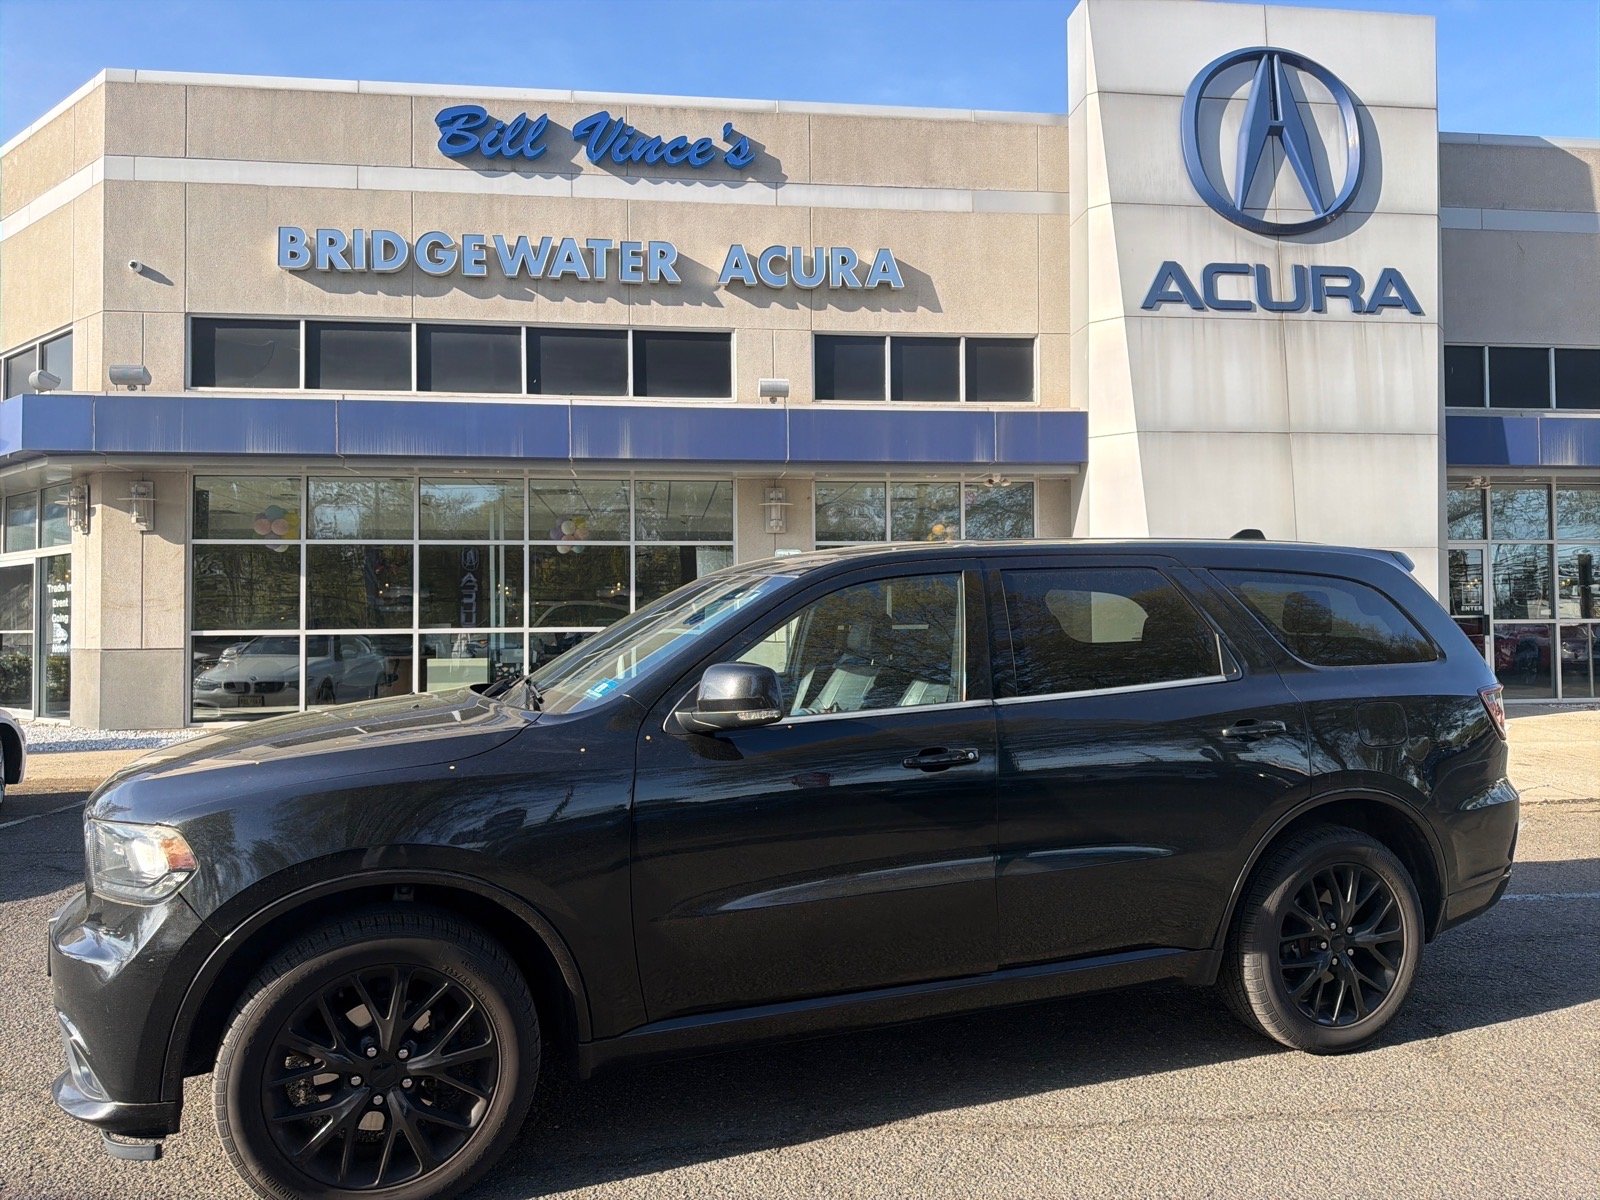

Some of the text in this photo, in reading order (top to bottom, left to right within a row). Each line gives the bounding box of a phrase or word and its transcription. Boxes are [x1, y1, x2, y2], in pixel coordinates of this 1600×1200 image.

[435, 104, 755, 170] Bill Vince's
[277, 226, 905, 290] BRIDGEWATER ACURA
[1141, 260, 1423, 315] ACURA
[47, 583, 65, 593] Trade
[52, 598, 69, 608] Event
[52, 613, 69, 624] Going
